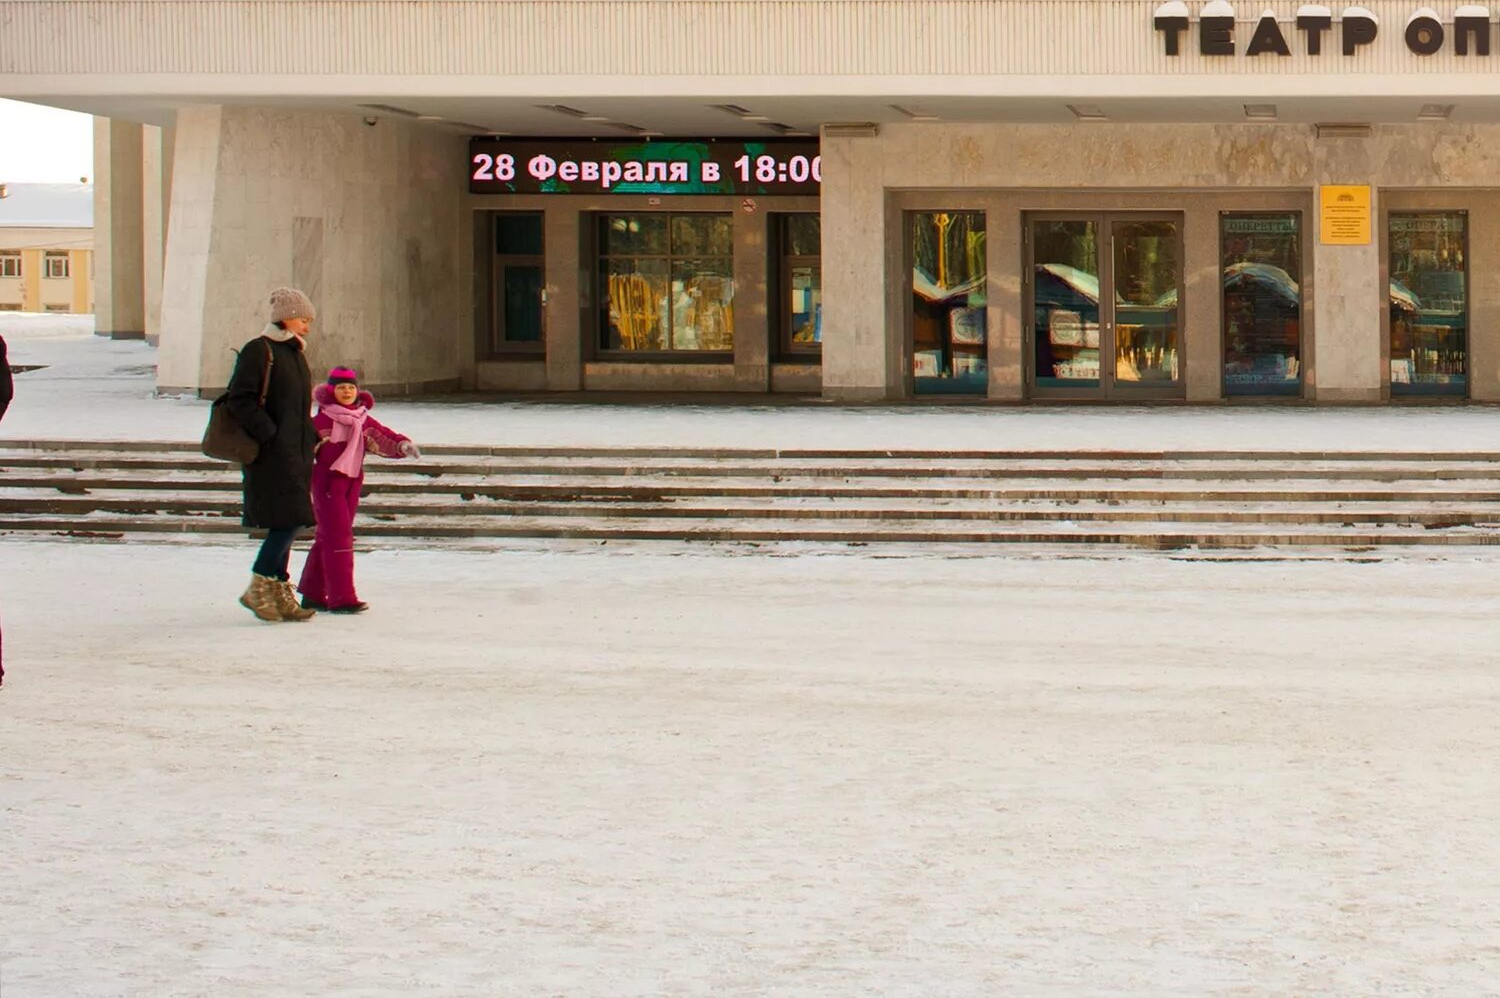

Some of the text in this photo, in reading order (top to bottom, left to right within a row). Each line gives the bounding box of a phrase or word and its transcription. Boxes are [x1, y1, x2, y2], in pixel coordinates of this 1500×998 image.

[1153, 15, 1379, 57] ТЕАТР
[473, 153, 516, 181] 28
[528, 154, 688, 188] Февраля
[702, 161, 721, 182] в
